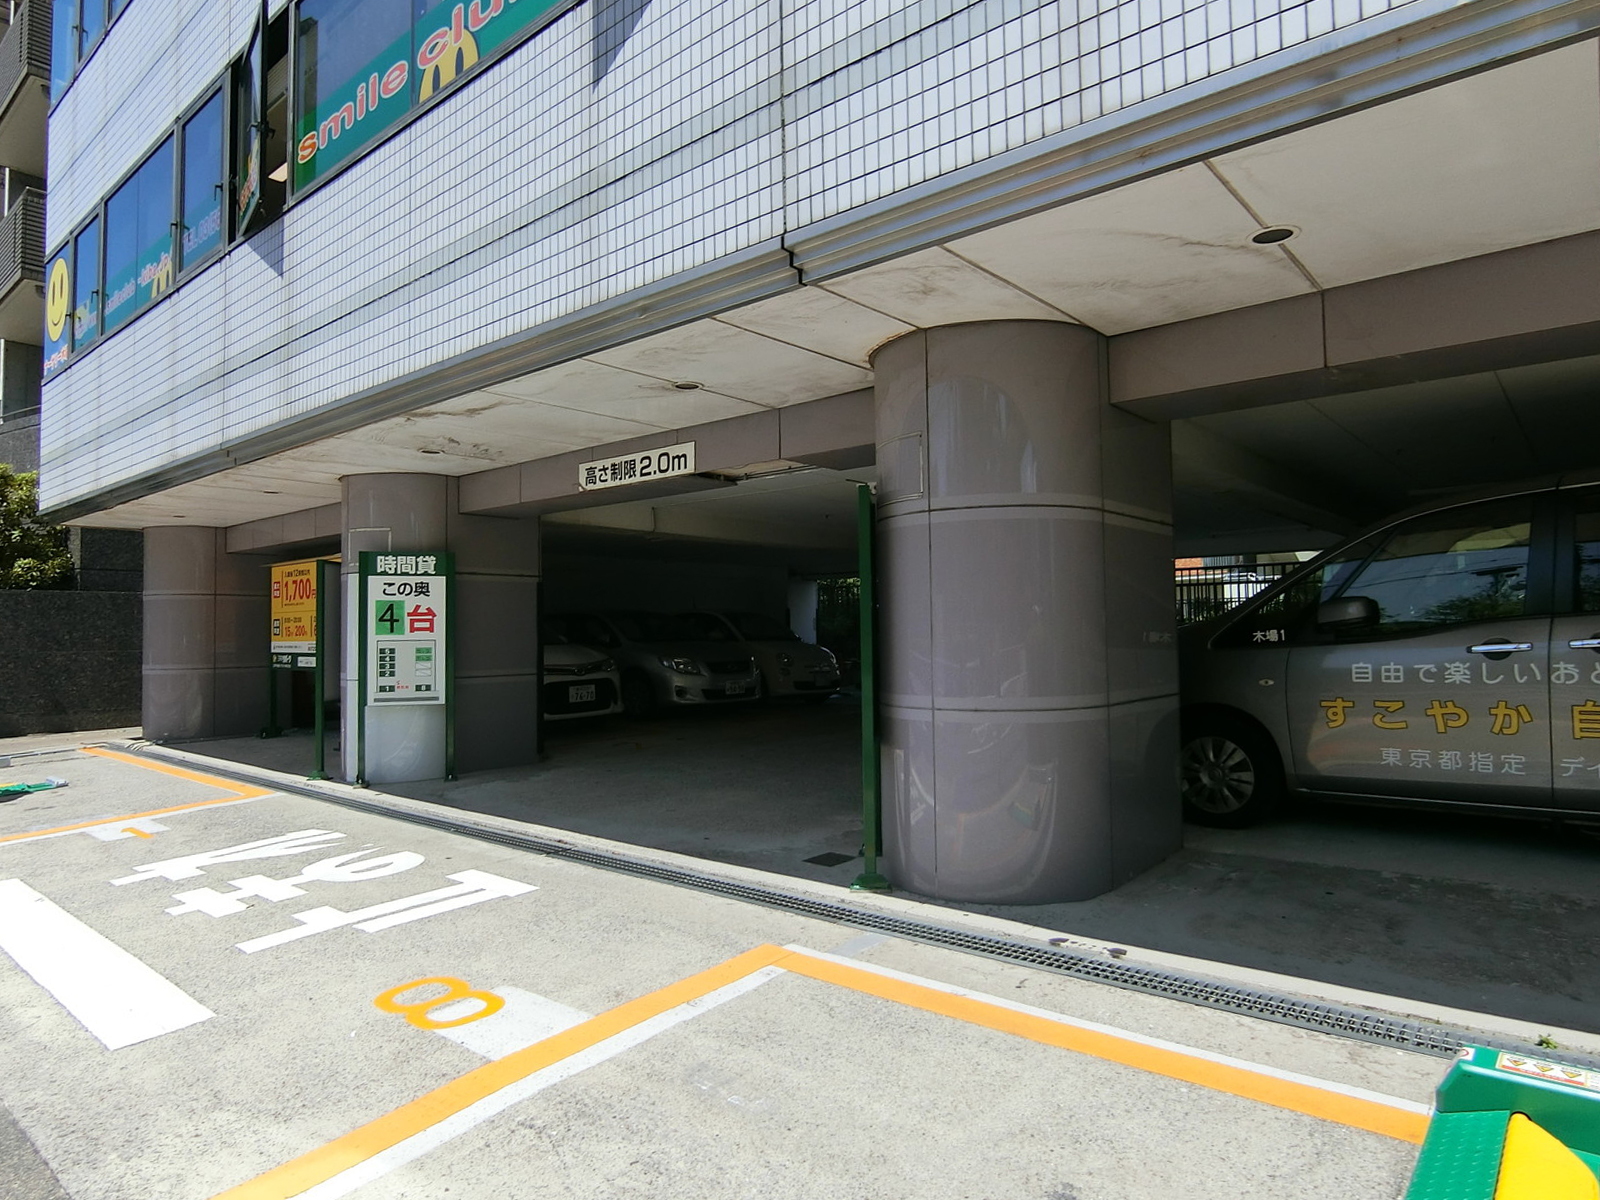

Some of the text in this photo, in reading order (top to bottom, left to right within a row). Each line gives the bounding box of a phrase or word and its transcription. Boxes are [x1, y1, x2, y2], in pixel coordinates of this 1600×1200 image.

[298, 0, 516, 164] smile clu
[376, 555, 436, 574] 時間貸
[382, 581, 430, 597] この奥
[1253, 629, 1285, 642] 木場1
[1379, 747, 1526, 775] 東京都指定
[374, 976, 505, 1030] 8
